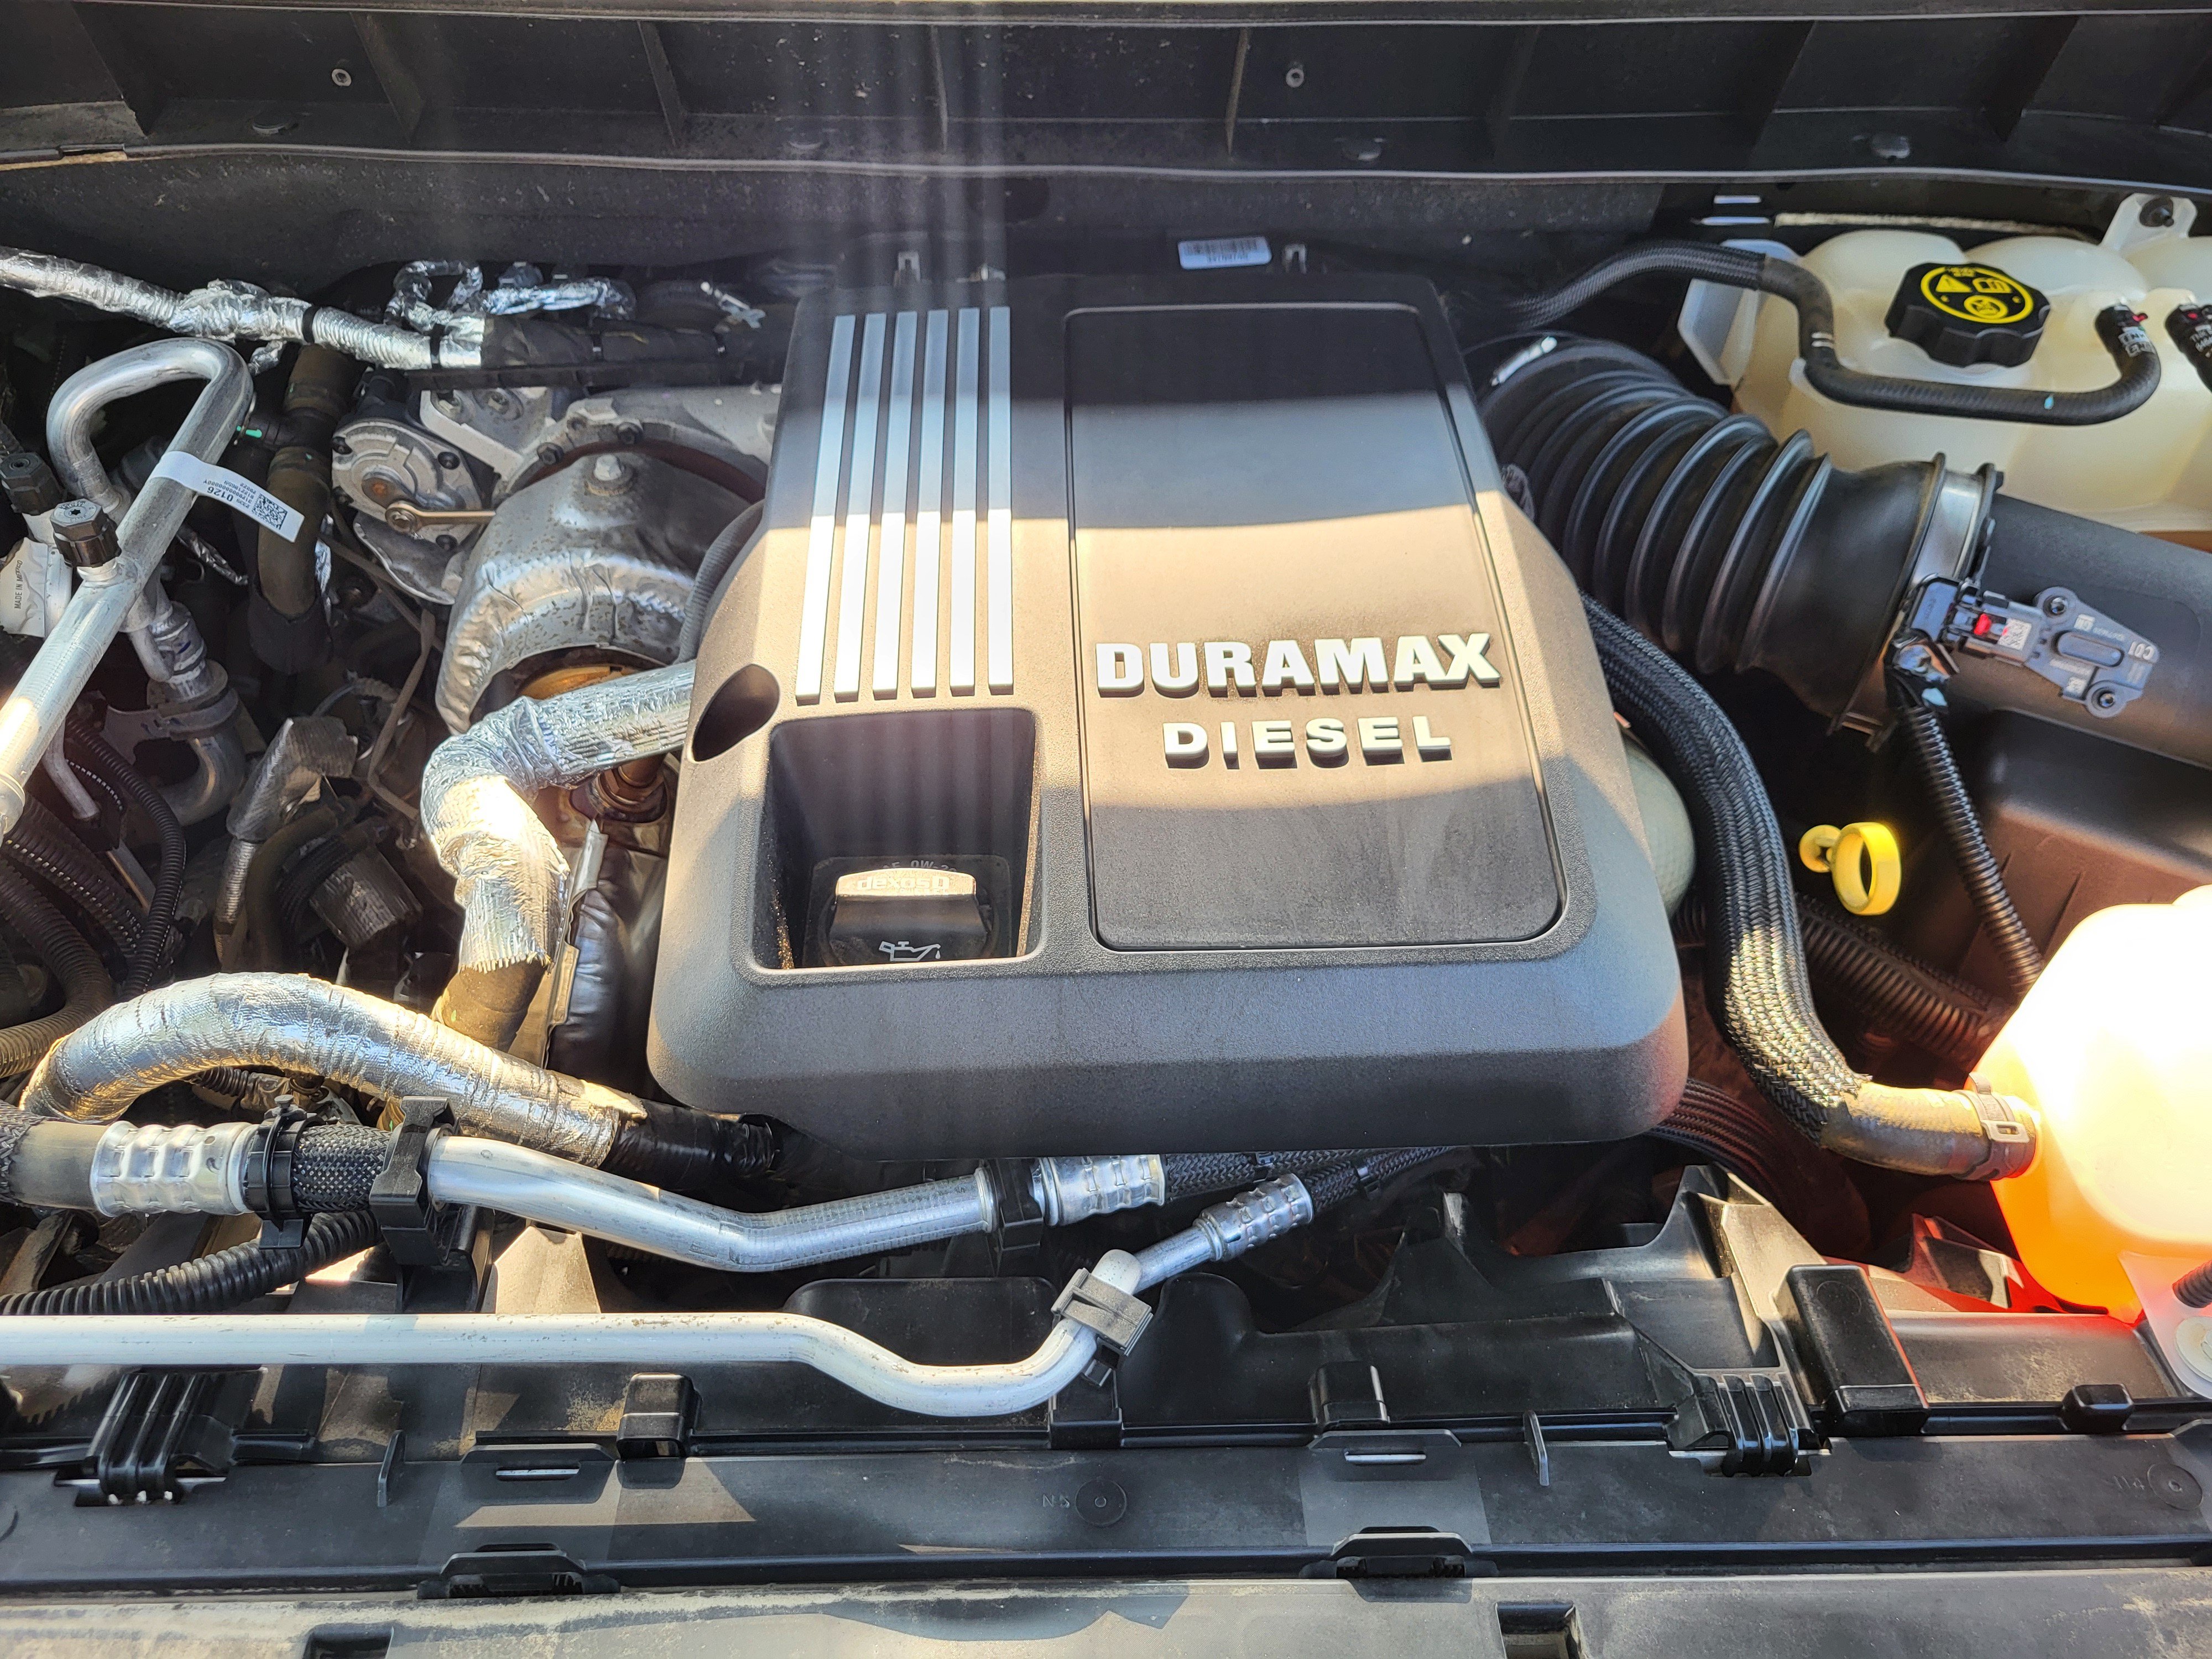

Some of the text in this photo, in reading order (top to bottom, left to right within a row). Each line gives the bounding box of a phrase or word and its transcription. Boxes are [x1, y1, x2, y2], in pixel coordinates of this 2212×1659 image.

[207, 486, 233, 502] 0126
[15, 560, 23, 582] MEXICO
[14, 591, 23, 609] MADE
[1095, 633, 1501, 698] DURAMAX
[1162, 716, 1452, 769] DIESEL
